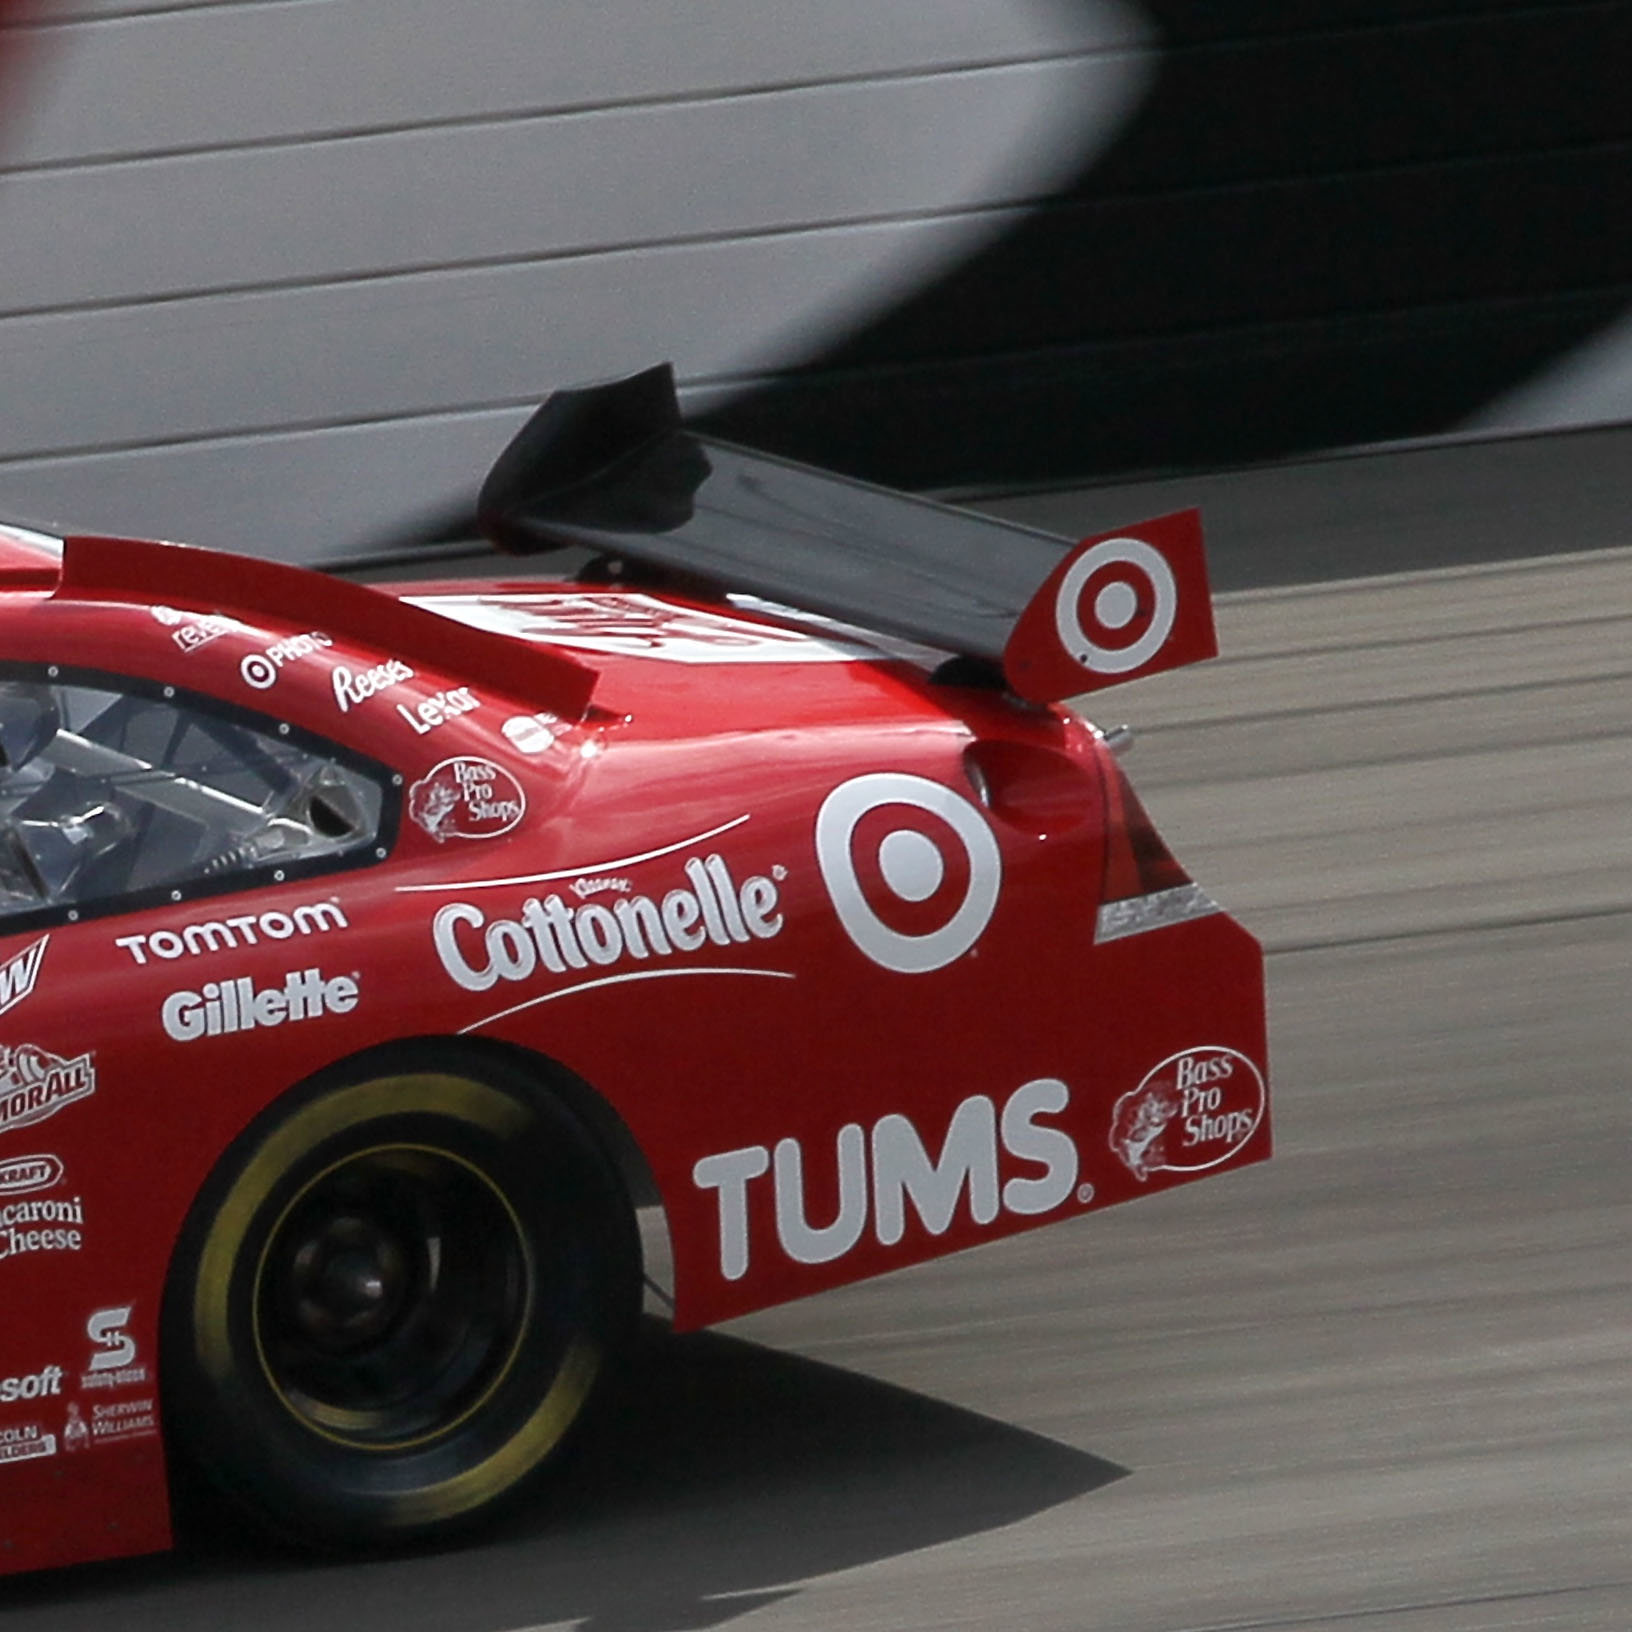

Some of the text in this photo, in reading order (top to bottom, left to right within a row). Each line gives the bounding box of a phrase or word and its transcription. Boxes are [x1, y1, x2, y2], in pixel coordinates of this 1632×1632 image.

[396, 687, 481, 735] Lexar
[453, 762, 497, 784] Bass
[462, 781, 493, 802] Pro
[468, 799, 521, 822] Shops
[432, 853, 784, 992] Cottonelle
[161, 968, 360, 1042] Gillette
[1176, 1055, 1234, 1090] Bass
[1181, 1087, 1222, 1118] Pro
[1182, 1108, 1254, 1147] Shops
[692, 1077, 1079, 1282] TUMS
